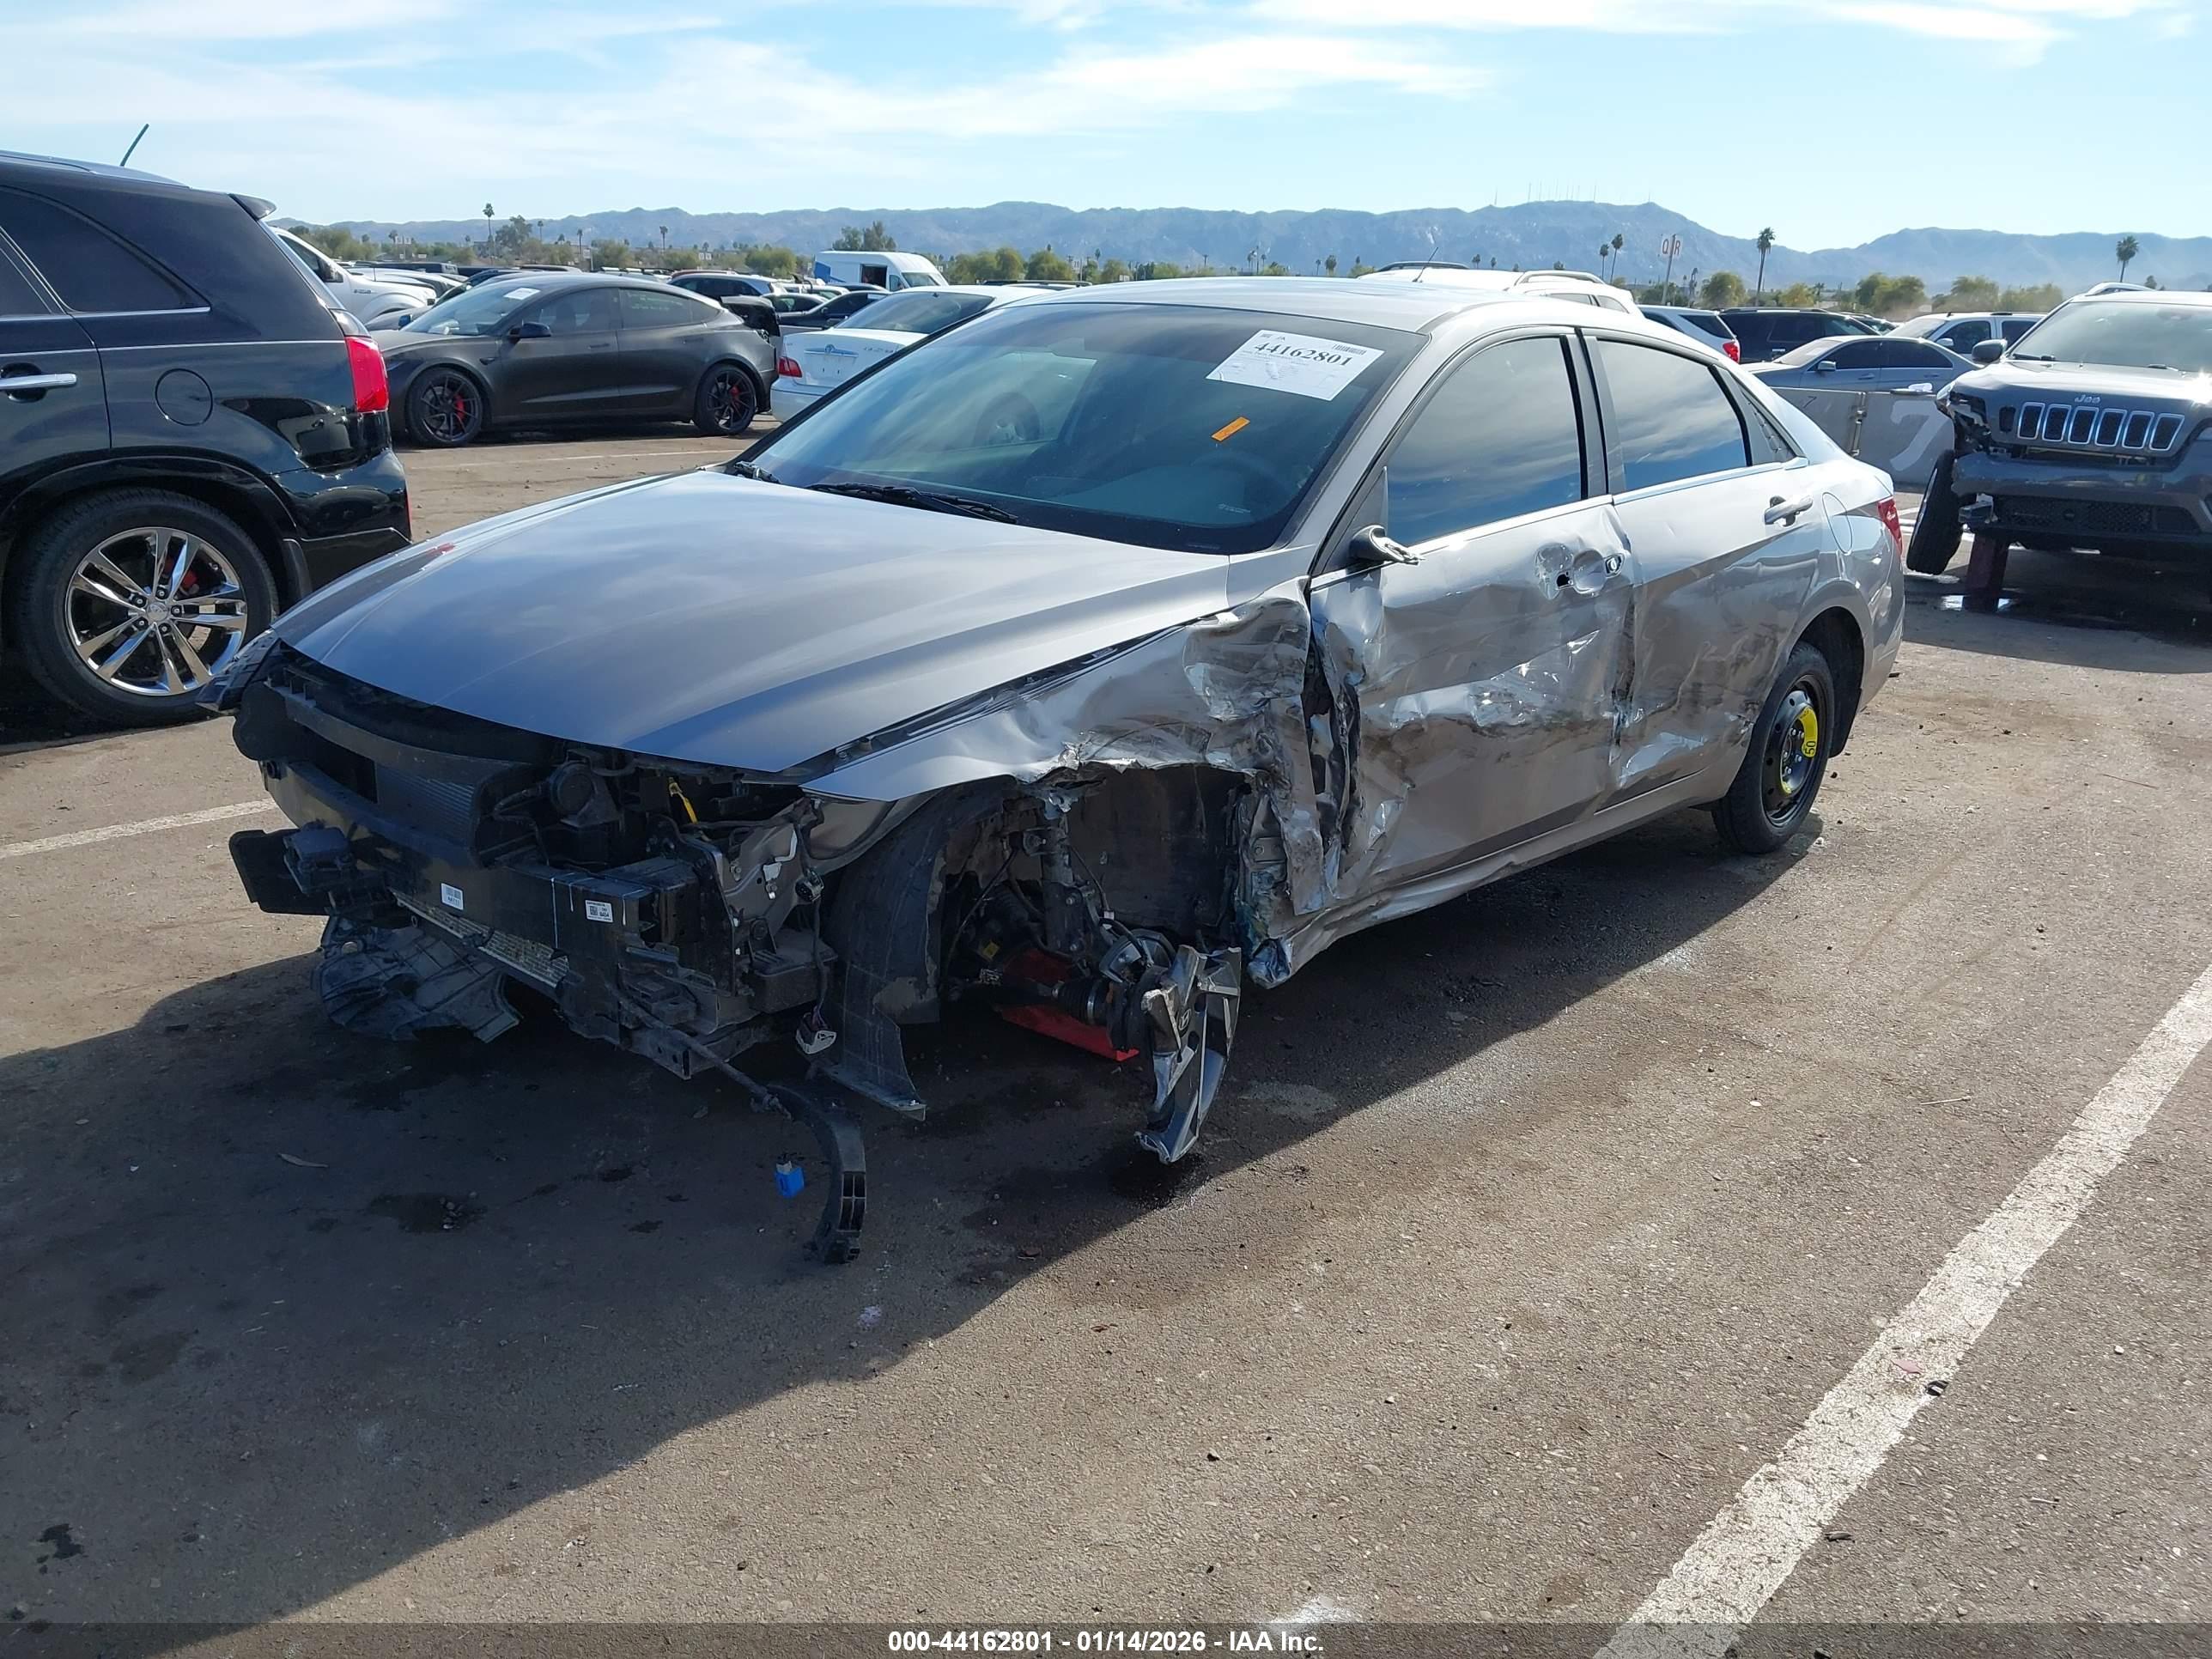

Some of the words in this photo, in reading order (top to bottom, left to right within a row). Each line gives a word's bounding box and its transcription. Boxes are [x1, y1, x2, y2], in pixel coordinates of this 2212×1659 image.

[1662, 239, 1668, 255] Q
[1674, 240, 1680, 255] R
[1255, 343, 1352, 366] 44162801
[1805, 740, 1816, 755] 50
